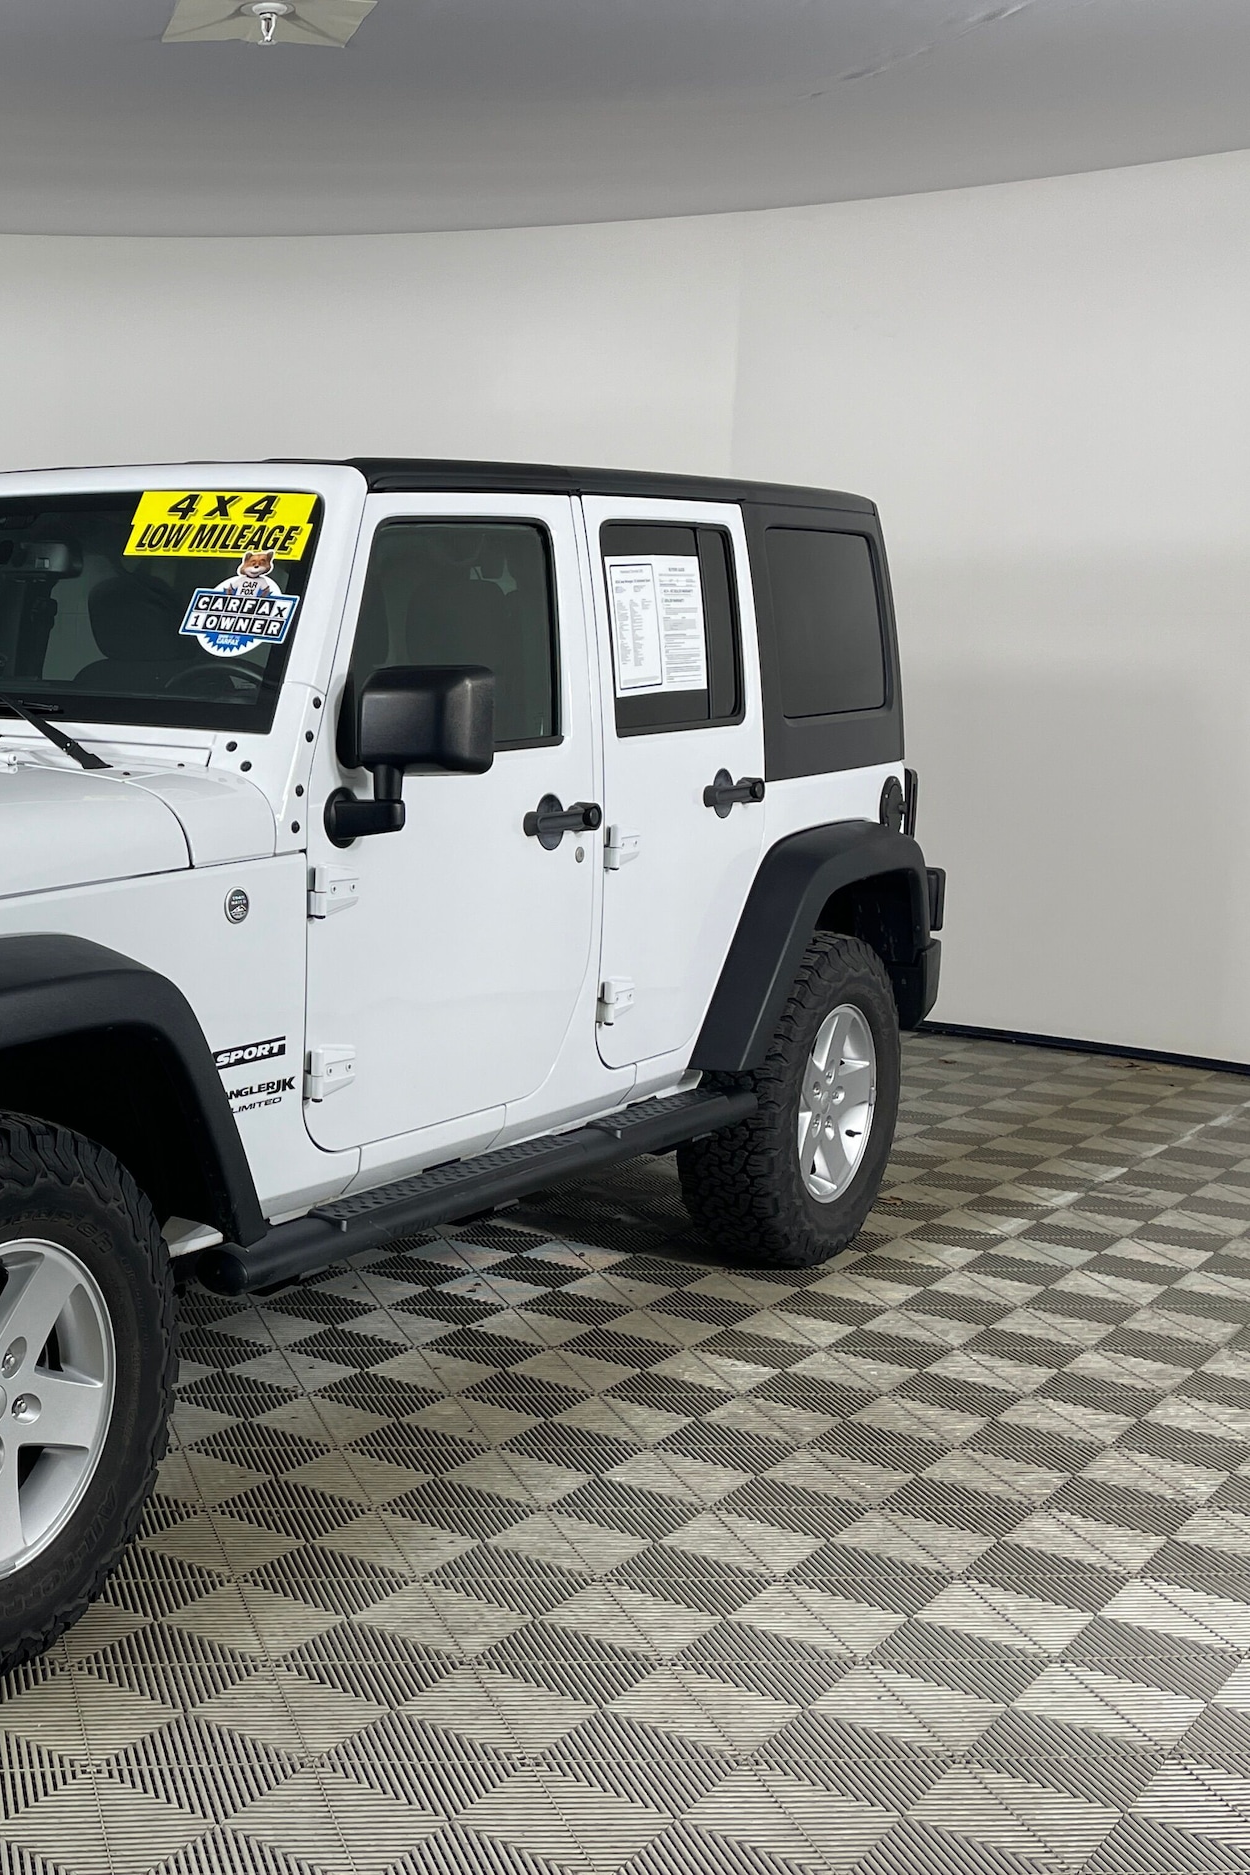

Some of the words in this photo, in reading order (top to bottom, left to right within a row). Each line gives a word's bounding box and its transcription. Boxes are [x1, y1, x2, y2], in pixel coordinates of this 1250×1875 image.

[167, 493, 201, 522] 4
[243, 495, 280, 523] 4
[135, 523, 194, 552] LOW
[189, 524, 302, 554] MILEAGE
[240, 588, 255, 596] FOX
[242, 581, 258, 589] CAR
[197, 596, 288, 618] CARFAX
[190, 614, 200, 627] 1
[205, 614, 281, 635] OWNER
[215, 1040, 286, 1067] SPORT
